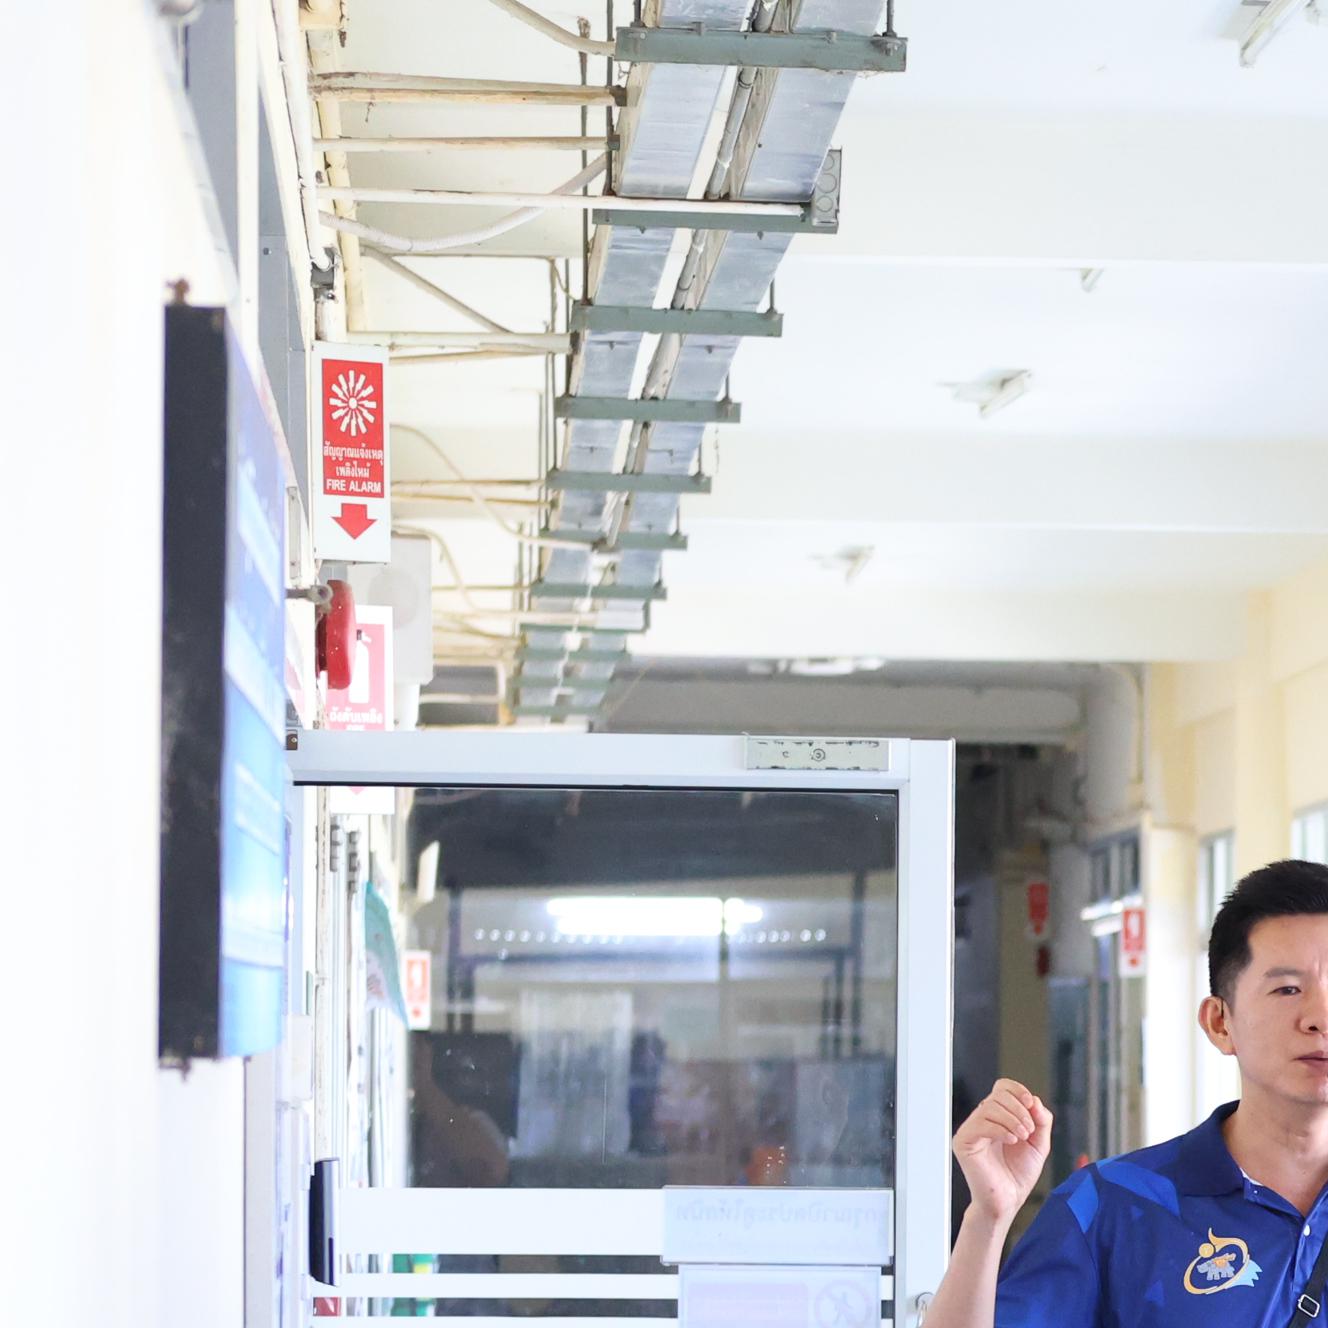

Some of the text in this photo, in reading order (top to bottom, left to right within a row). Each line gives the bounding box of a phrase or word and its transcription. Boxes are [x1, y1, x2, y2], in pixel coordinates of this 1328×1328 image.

[323, 440, 384, 466] สัญญาณแจ้งเหตุ
[335, 460, 370, 478] เพลิงไหม้
[326, 478, 382, 493] FIRE ALARM
